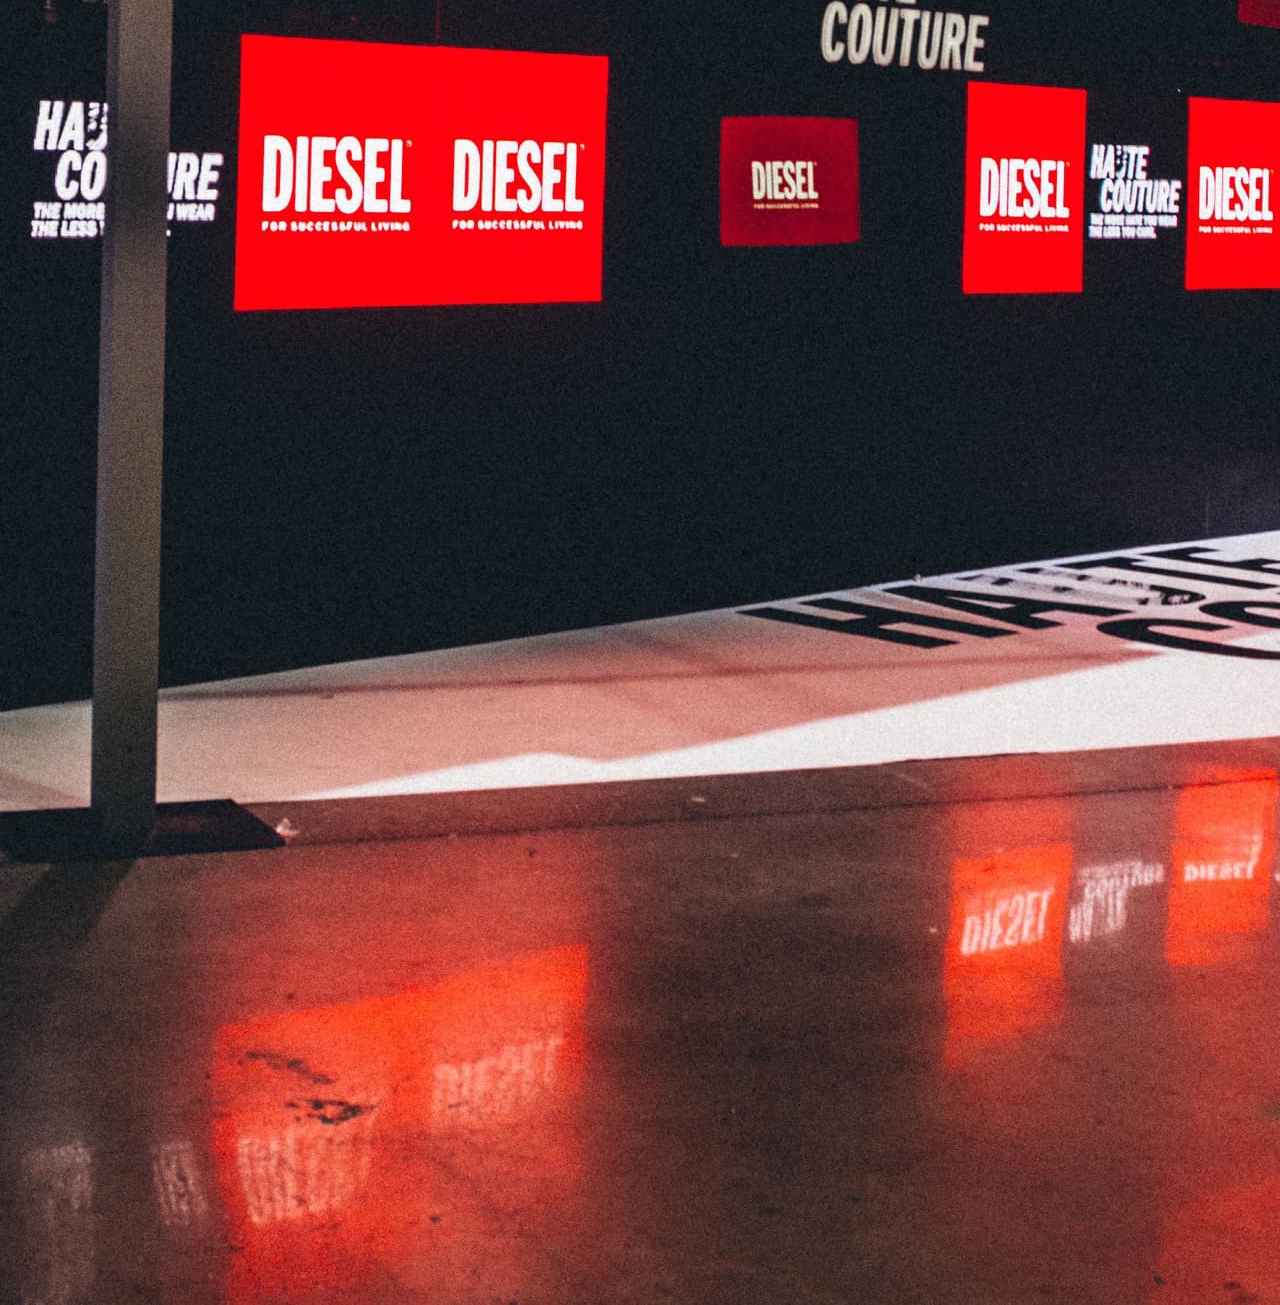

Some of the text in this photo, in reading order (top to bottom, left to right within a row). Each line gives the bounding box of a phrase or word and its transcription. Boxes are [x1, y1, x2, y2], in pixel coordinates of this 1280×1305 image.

[821, 0, 990, 72] COUTURE
[33, 100, 108, 151] HAU
[55, 150, 224, 201] CORE
[262, 135, 412, 214] DIESEL
[452, 139, 584, 214] DIESEL
[752, 160, 819, 200] DIESEL
[979, 157, 1070, 219] DIESEL
[1100, 179, 1182, 214] COUTURE
[1199, 166, 1274, 222] DIESEL
[31, 220, 59, 238] THE
[33, 202, 62, 220] THE
[261, 220, 410, 233] FOR SUCCESSFUL LIVING
[452, 219, 583, 231] FOR SUCCESSFUL LIVING
